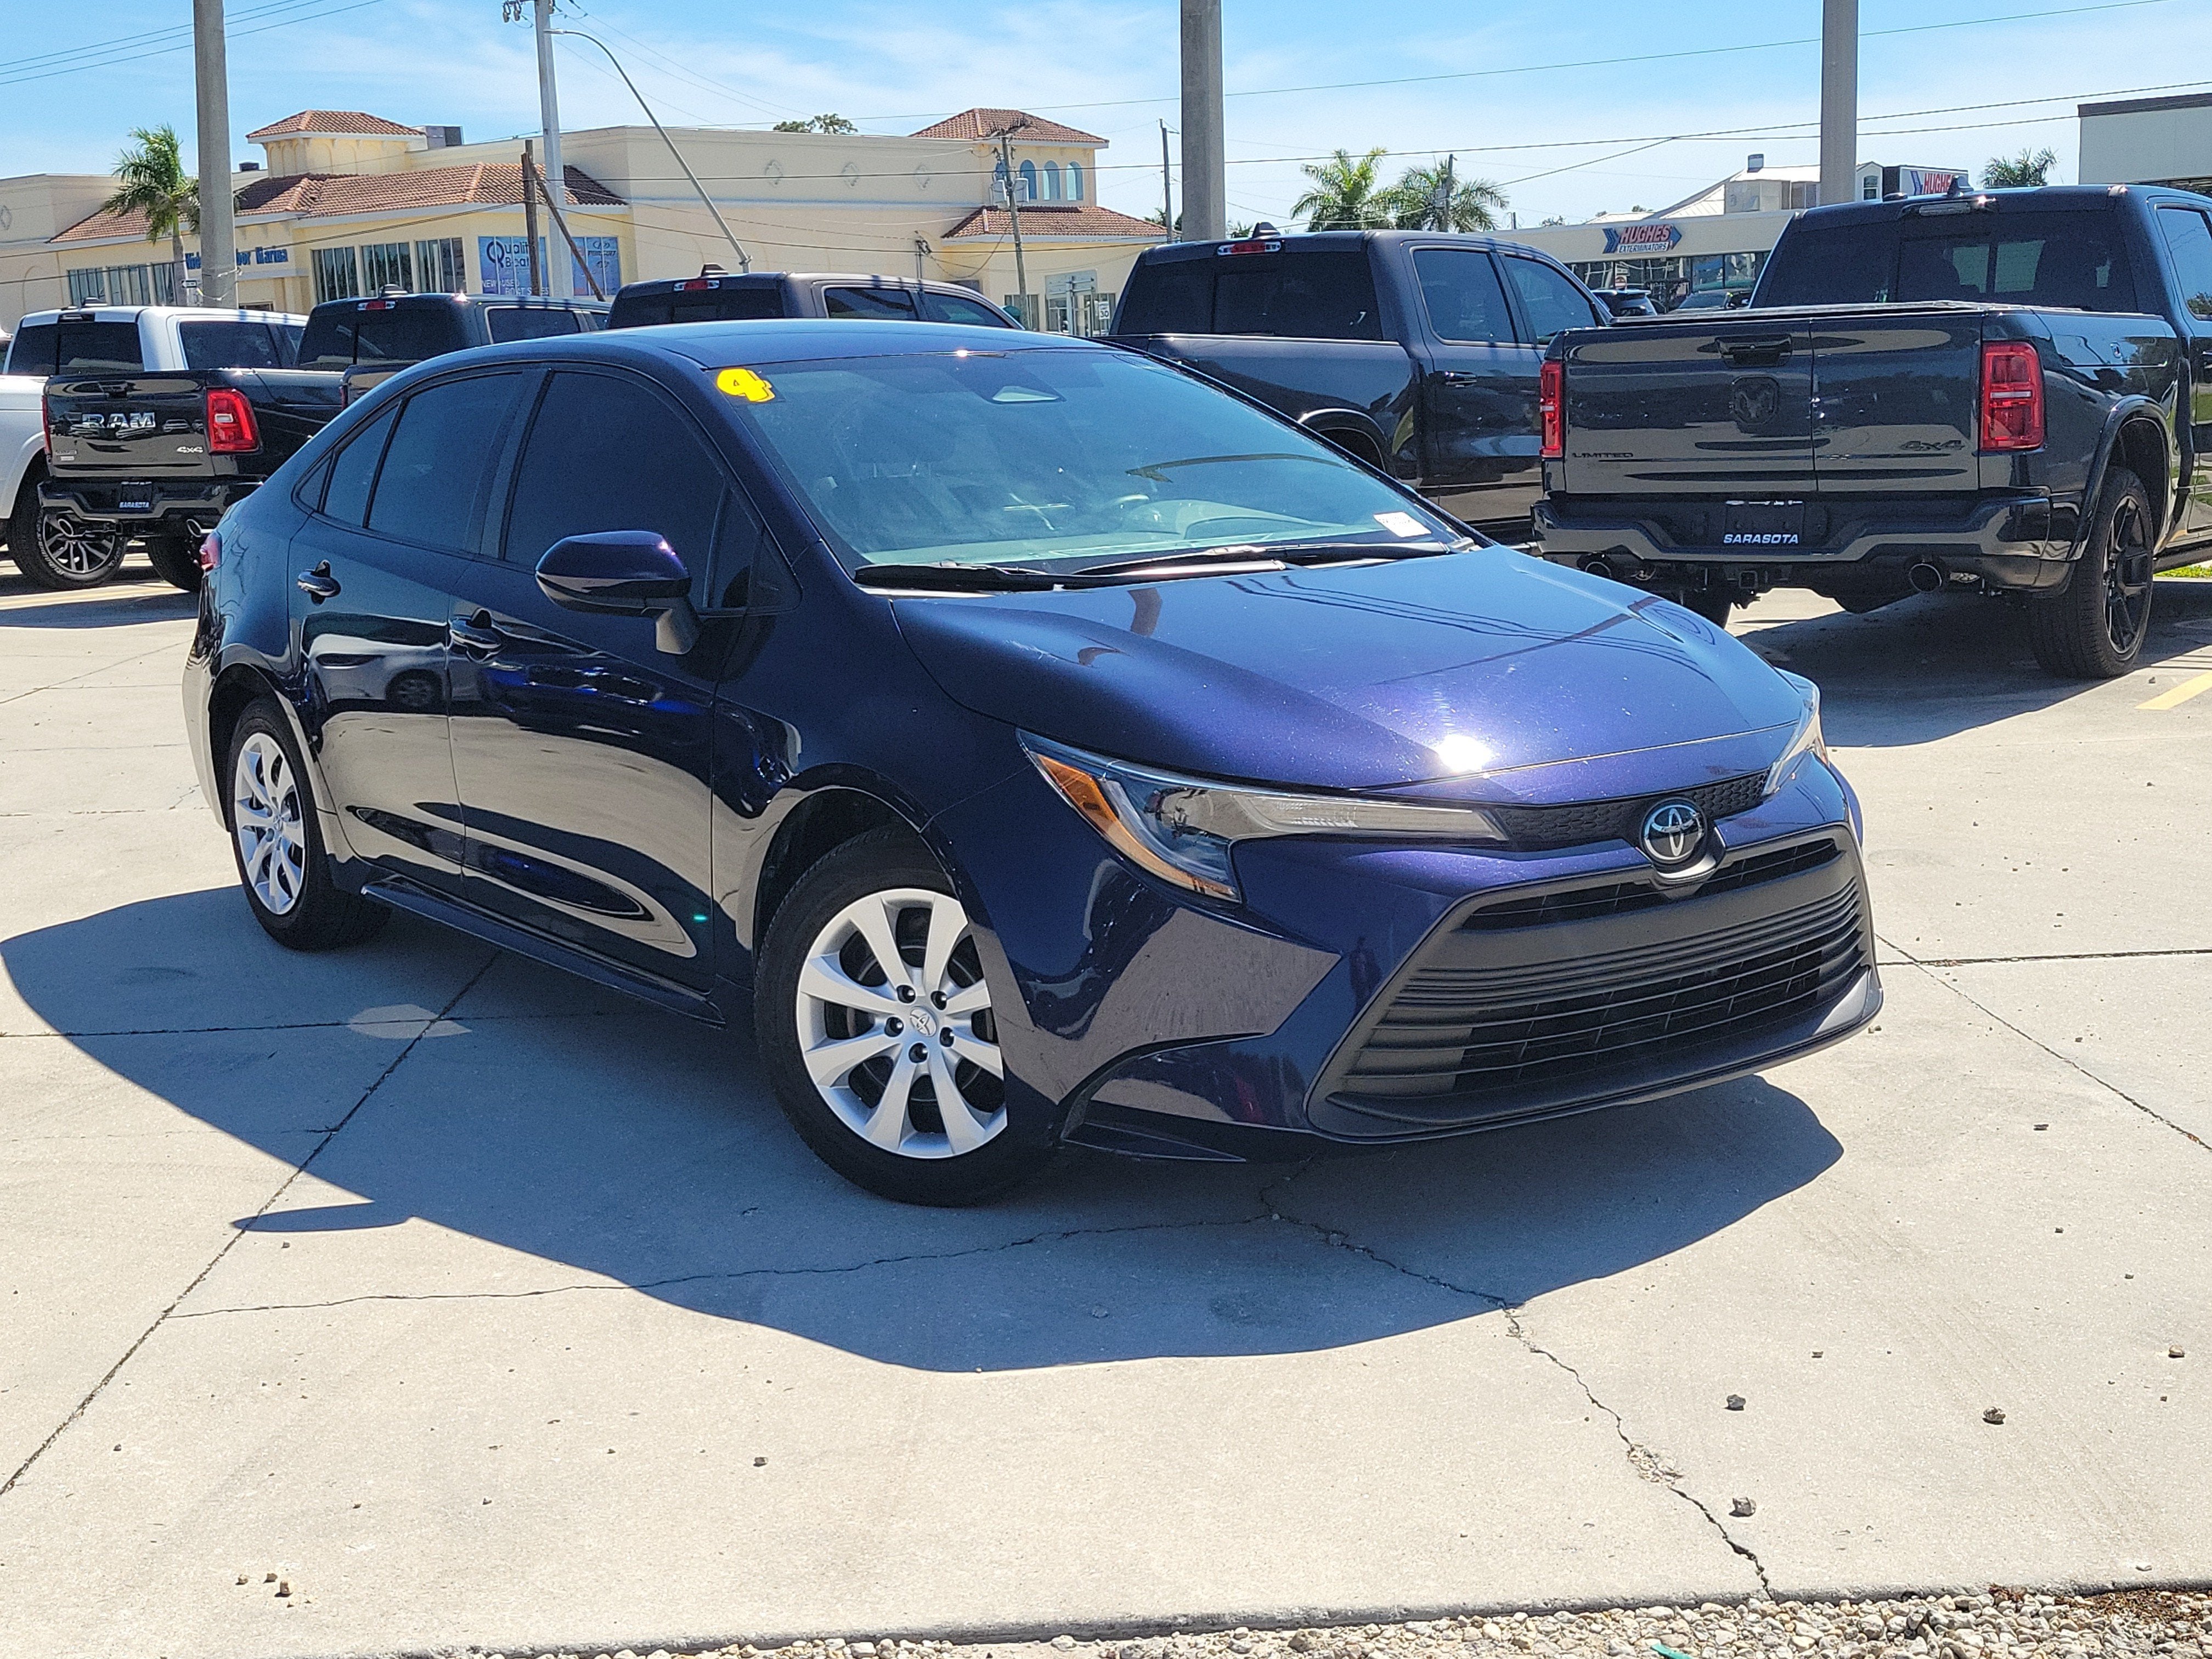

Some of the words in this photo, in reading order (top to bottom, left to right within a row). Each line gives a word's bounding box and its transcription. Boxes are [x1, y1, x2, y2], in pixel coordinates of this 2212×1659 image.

[1923, 173, 1953, 194] HUGHE
[1620, 224, 1671, 244] HUGHES
[486, 241, 529, 268] Qualit
[1618, 242, 1667, 252] EXTERMINATORS
[82, 413, 155, 428] RAM
[1723, 534, 1799, 544] SARASOTA
